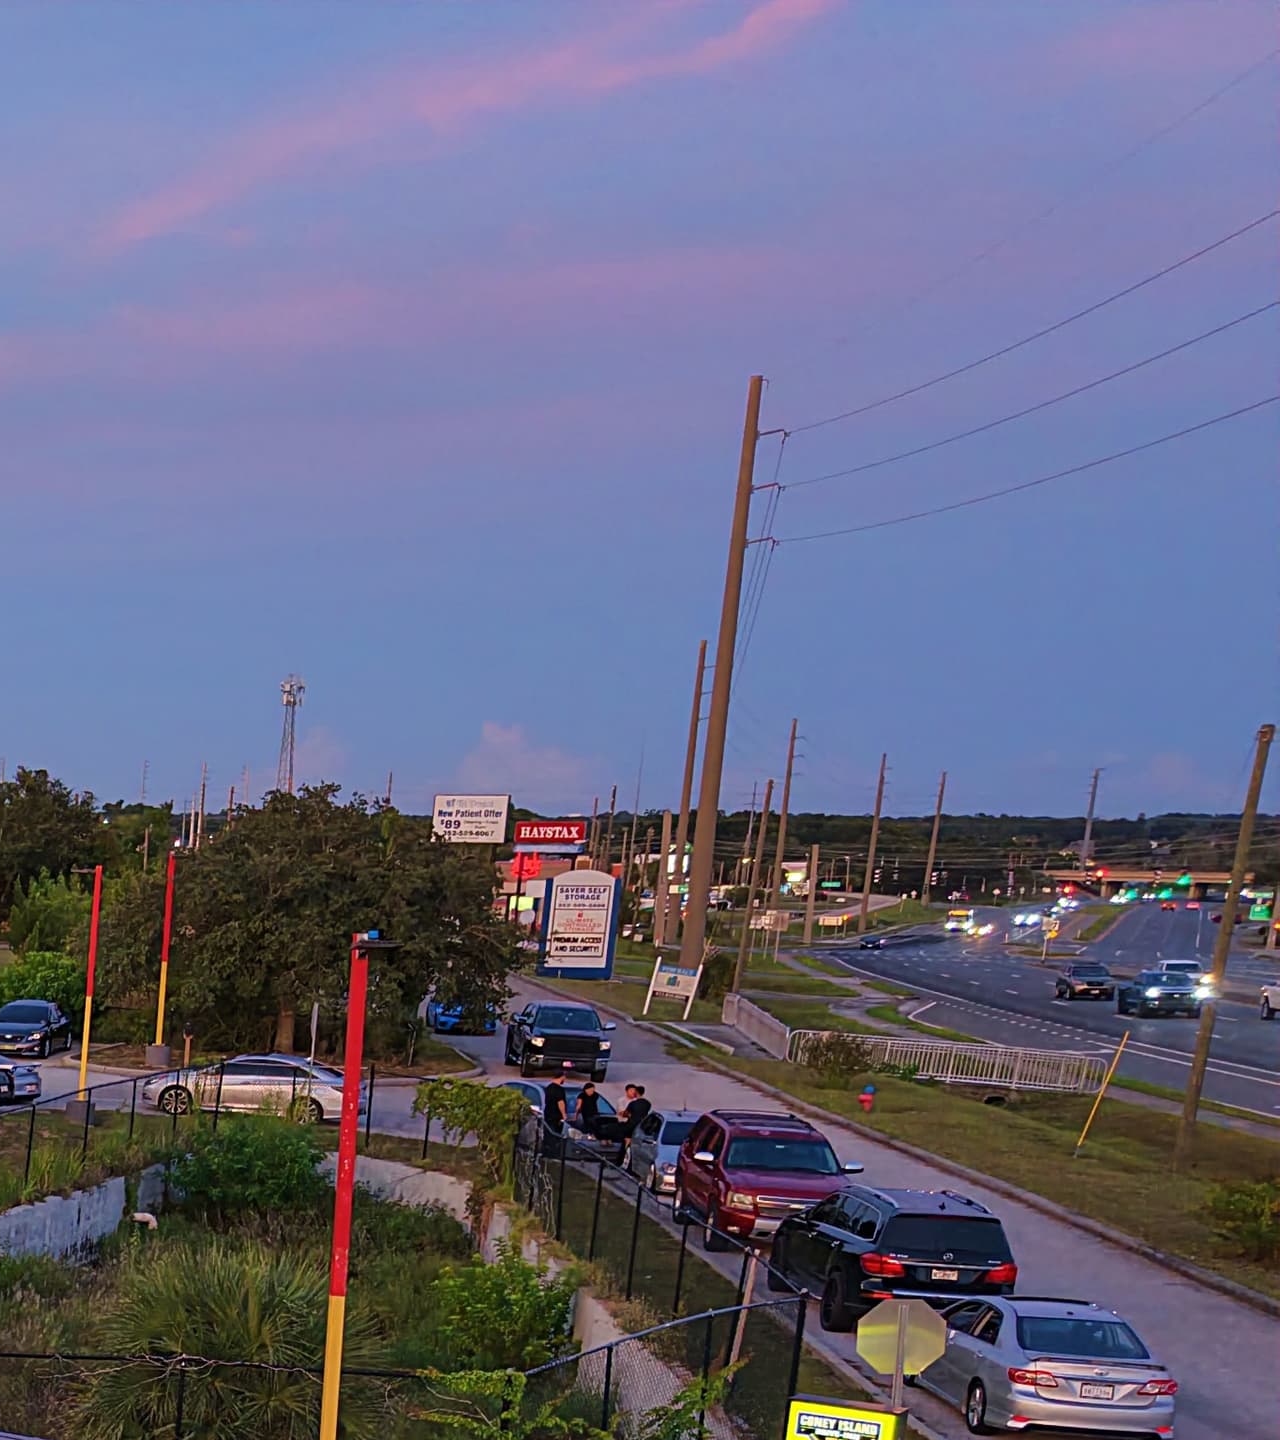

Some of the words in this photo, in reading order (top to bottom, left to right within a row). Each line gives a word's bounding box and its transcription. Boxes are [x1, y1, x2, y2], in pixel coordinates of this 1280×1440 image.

[438, 809, 453, 818] New
[455, 809, 482, 818] Patient
[484, 809, 503, 818] Offer
[440, 819, 461, 829] $89
[520, 826, 580, 839] HAYSTAX
[800, 1415, 837, 1429] CONEY
[838, 1420, 879, 1436] ISLAND
